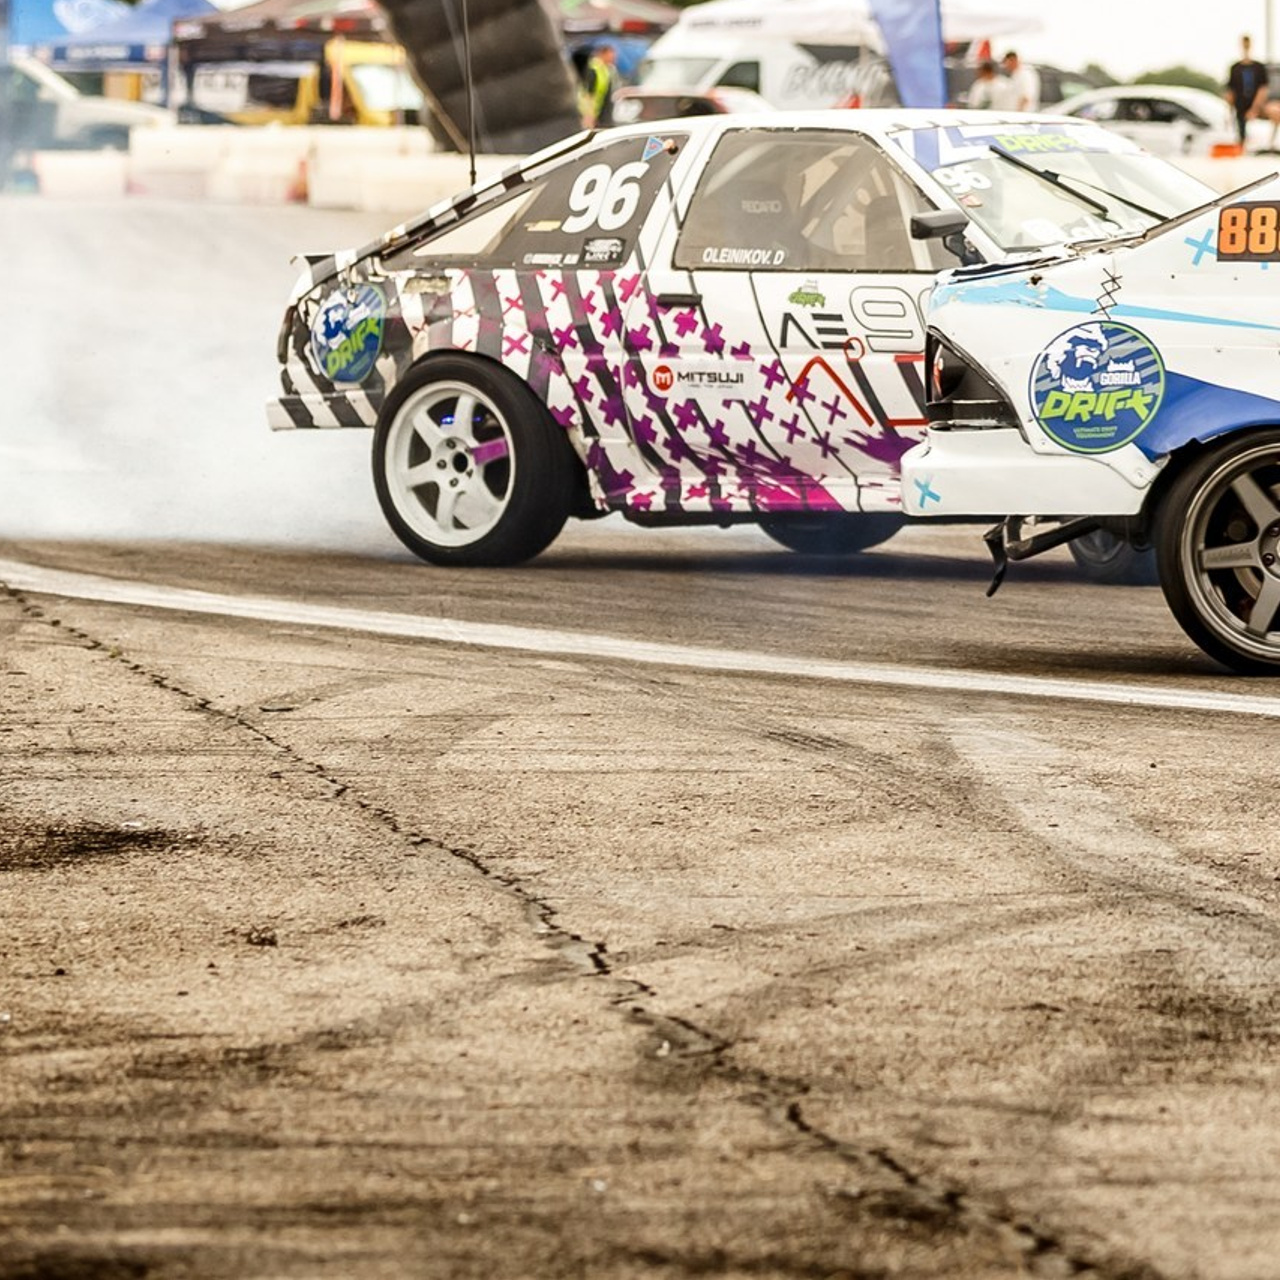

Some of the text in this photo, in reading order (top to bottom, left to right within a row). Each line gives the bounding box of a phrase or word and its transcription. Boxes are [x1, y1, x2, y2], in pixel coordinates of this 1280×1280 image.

[932, 164, 992, 195] 96
[561, 161, 649, 234] 96
[702, 247, 785, 265] OLEINIKOV. D
[677, 371, 743, 384] MITSUJI
[1100, 371, 1141, 385] GORILLA
[1041, 389, 1153, 422] DRIFT
